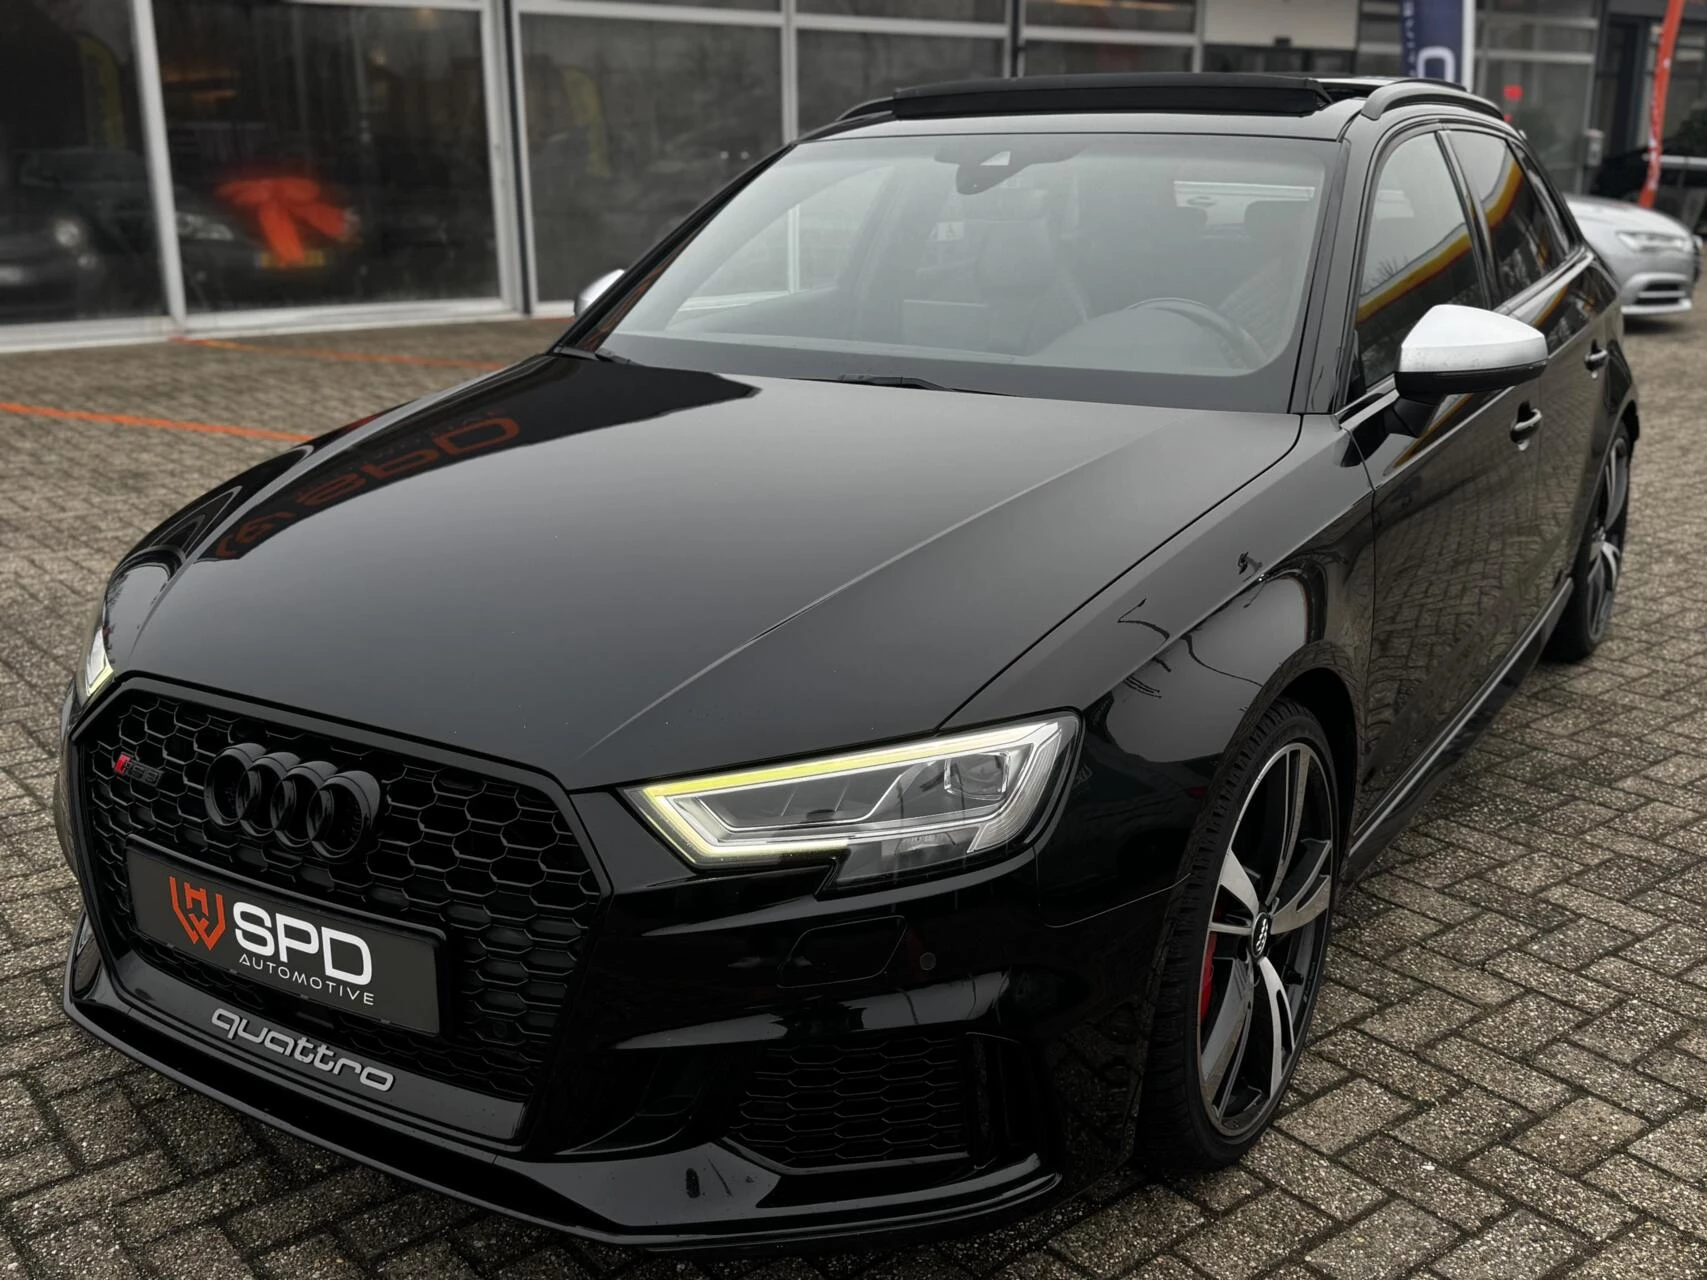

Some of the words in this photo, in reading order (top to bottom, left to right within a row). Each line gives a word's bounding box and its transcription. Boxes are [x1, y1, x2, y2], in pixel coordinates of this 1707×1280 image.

[232, 901, 373, 986] SPD
[239, 953, 375, 1006] AUTOMOTIVE
[211, 1007, 394, 1092] quattro
